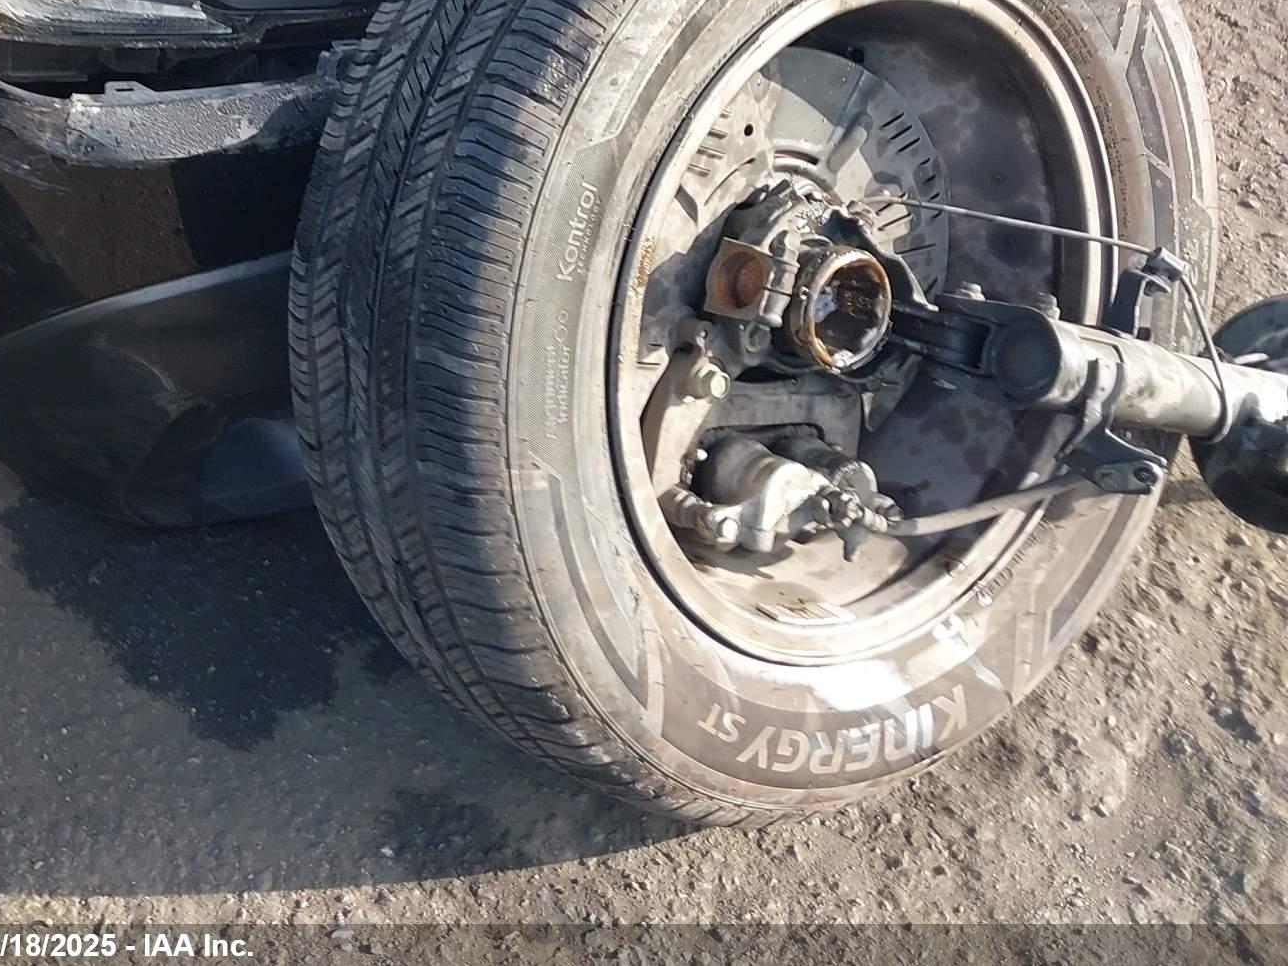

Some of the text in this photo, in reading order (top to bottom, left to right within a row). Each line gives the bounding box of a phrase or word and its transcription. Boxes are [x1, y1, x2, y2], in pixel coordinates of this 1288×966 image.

[556, 182, 598, 282] Kontrol
[697, 684, 969, 775] KINERGY ST
